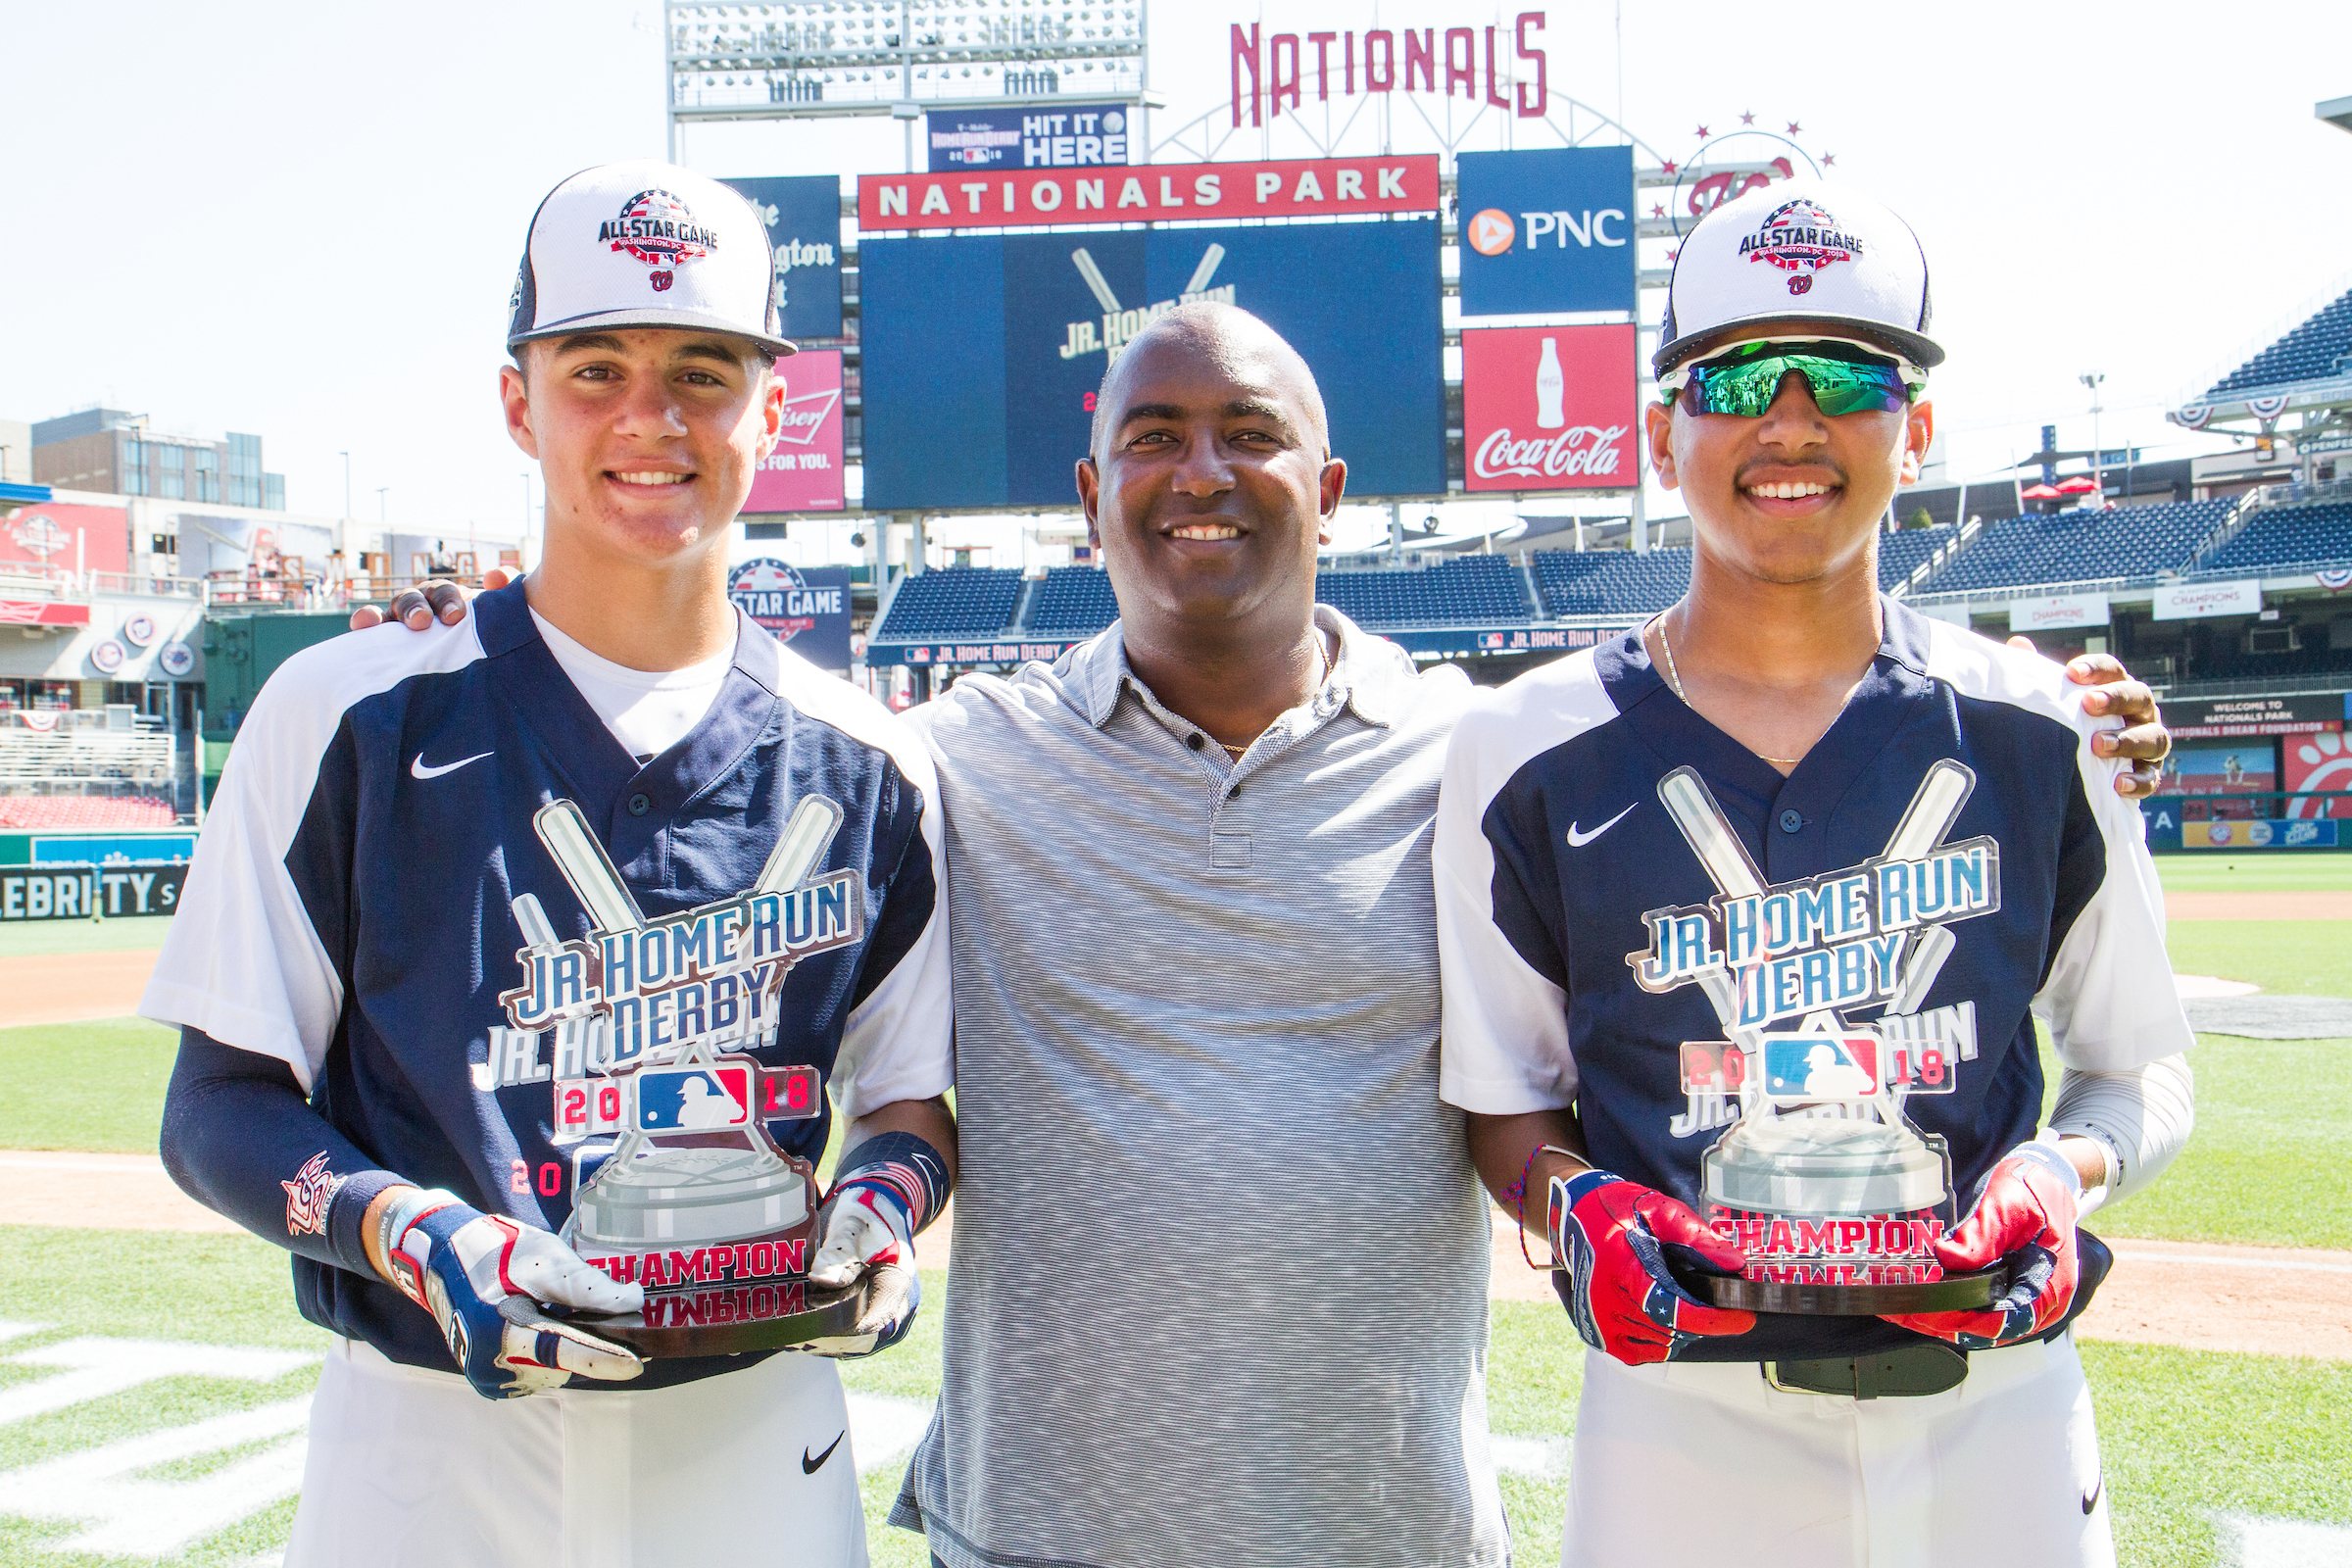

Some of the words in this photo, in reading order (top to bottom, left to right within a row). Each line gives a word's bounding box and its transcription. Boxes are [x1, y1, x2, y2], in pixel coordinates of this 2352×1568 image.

[1231, 12, 1546, 128] NATIONALS
[1023, 115, 1067, 136] HIT
[1074, 114, 1099, 134] IT
[1024, 134, 1126, 167] HERE
[879, 173, 1222, 217] NATIONALS
[1256, 168, 1407, 203] PARK
[679, 221, 718, 250] GAME
[1521, 209, 1626, 250] PNC
[1821, 230, 1863, 255] GAME
[1058, 321, 1102, 360] JR.
[768, 455, 797, 470] FOR
[799, 454, 831, 469] YOU.
[1474, 424, 1629, 478] Coca-Cola
[787, 591, 842, 615] GAME
[2172, 591, 2240, 606] CHAMPIONS
[936, 646, 955, 662] JR.
[956, 645, 990, 662] HOME
[993, 644, 1019, 662] RUN
[1021, 643, 1061, 661] DERBY
[1510, 631, 1531, 649] JR.
[1532, 630, 1567, 648] HOME
[1568, 629, 1594, 647] RUN
[2204, 712, 2263, 723] NATIONALS
[2265, 710, 2293, 720] PARK
[2213, 702, 2267, 712] WELCOME
[2268, 701, 2282, 710] TO
[2223, 724, 2258, 735] DREAM
[2260, 722, 2324, 733] FOUNDATION
[0, 873, 156, 918] EBRITY
[1635, 914, 1726, 986] JR.
[1723, 874, 1871, 968] HOME
[1875, 846, 1989, 932] RUN
[515, 950, 602, 1023] JR.
[600, 906, 744, 1002] HOME
[751, 877, 852, 962] RUN
[1731, 930, 1909, 1032] DERBY
[608, 961, 778, 1067] DERBY
[472, 1025, 551, 1091] JR.
[1688, 1050, 1745, 1086] 20
[1895, 1050, 1944, 1085] 18
[564, 1088, 620, 1125] 20
[764, 1074, 809, 1111] 18
[511, 1159, 562, 1198] 20
[1709, 1218, 1945, 1256] CHAMPION
